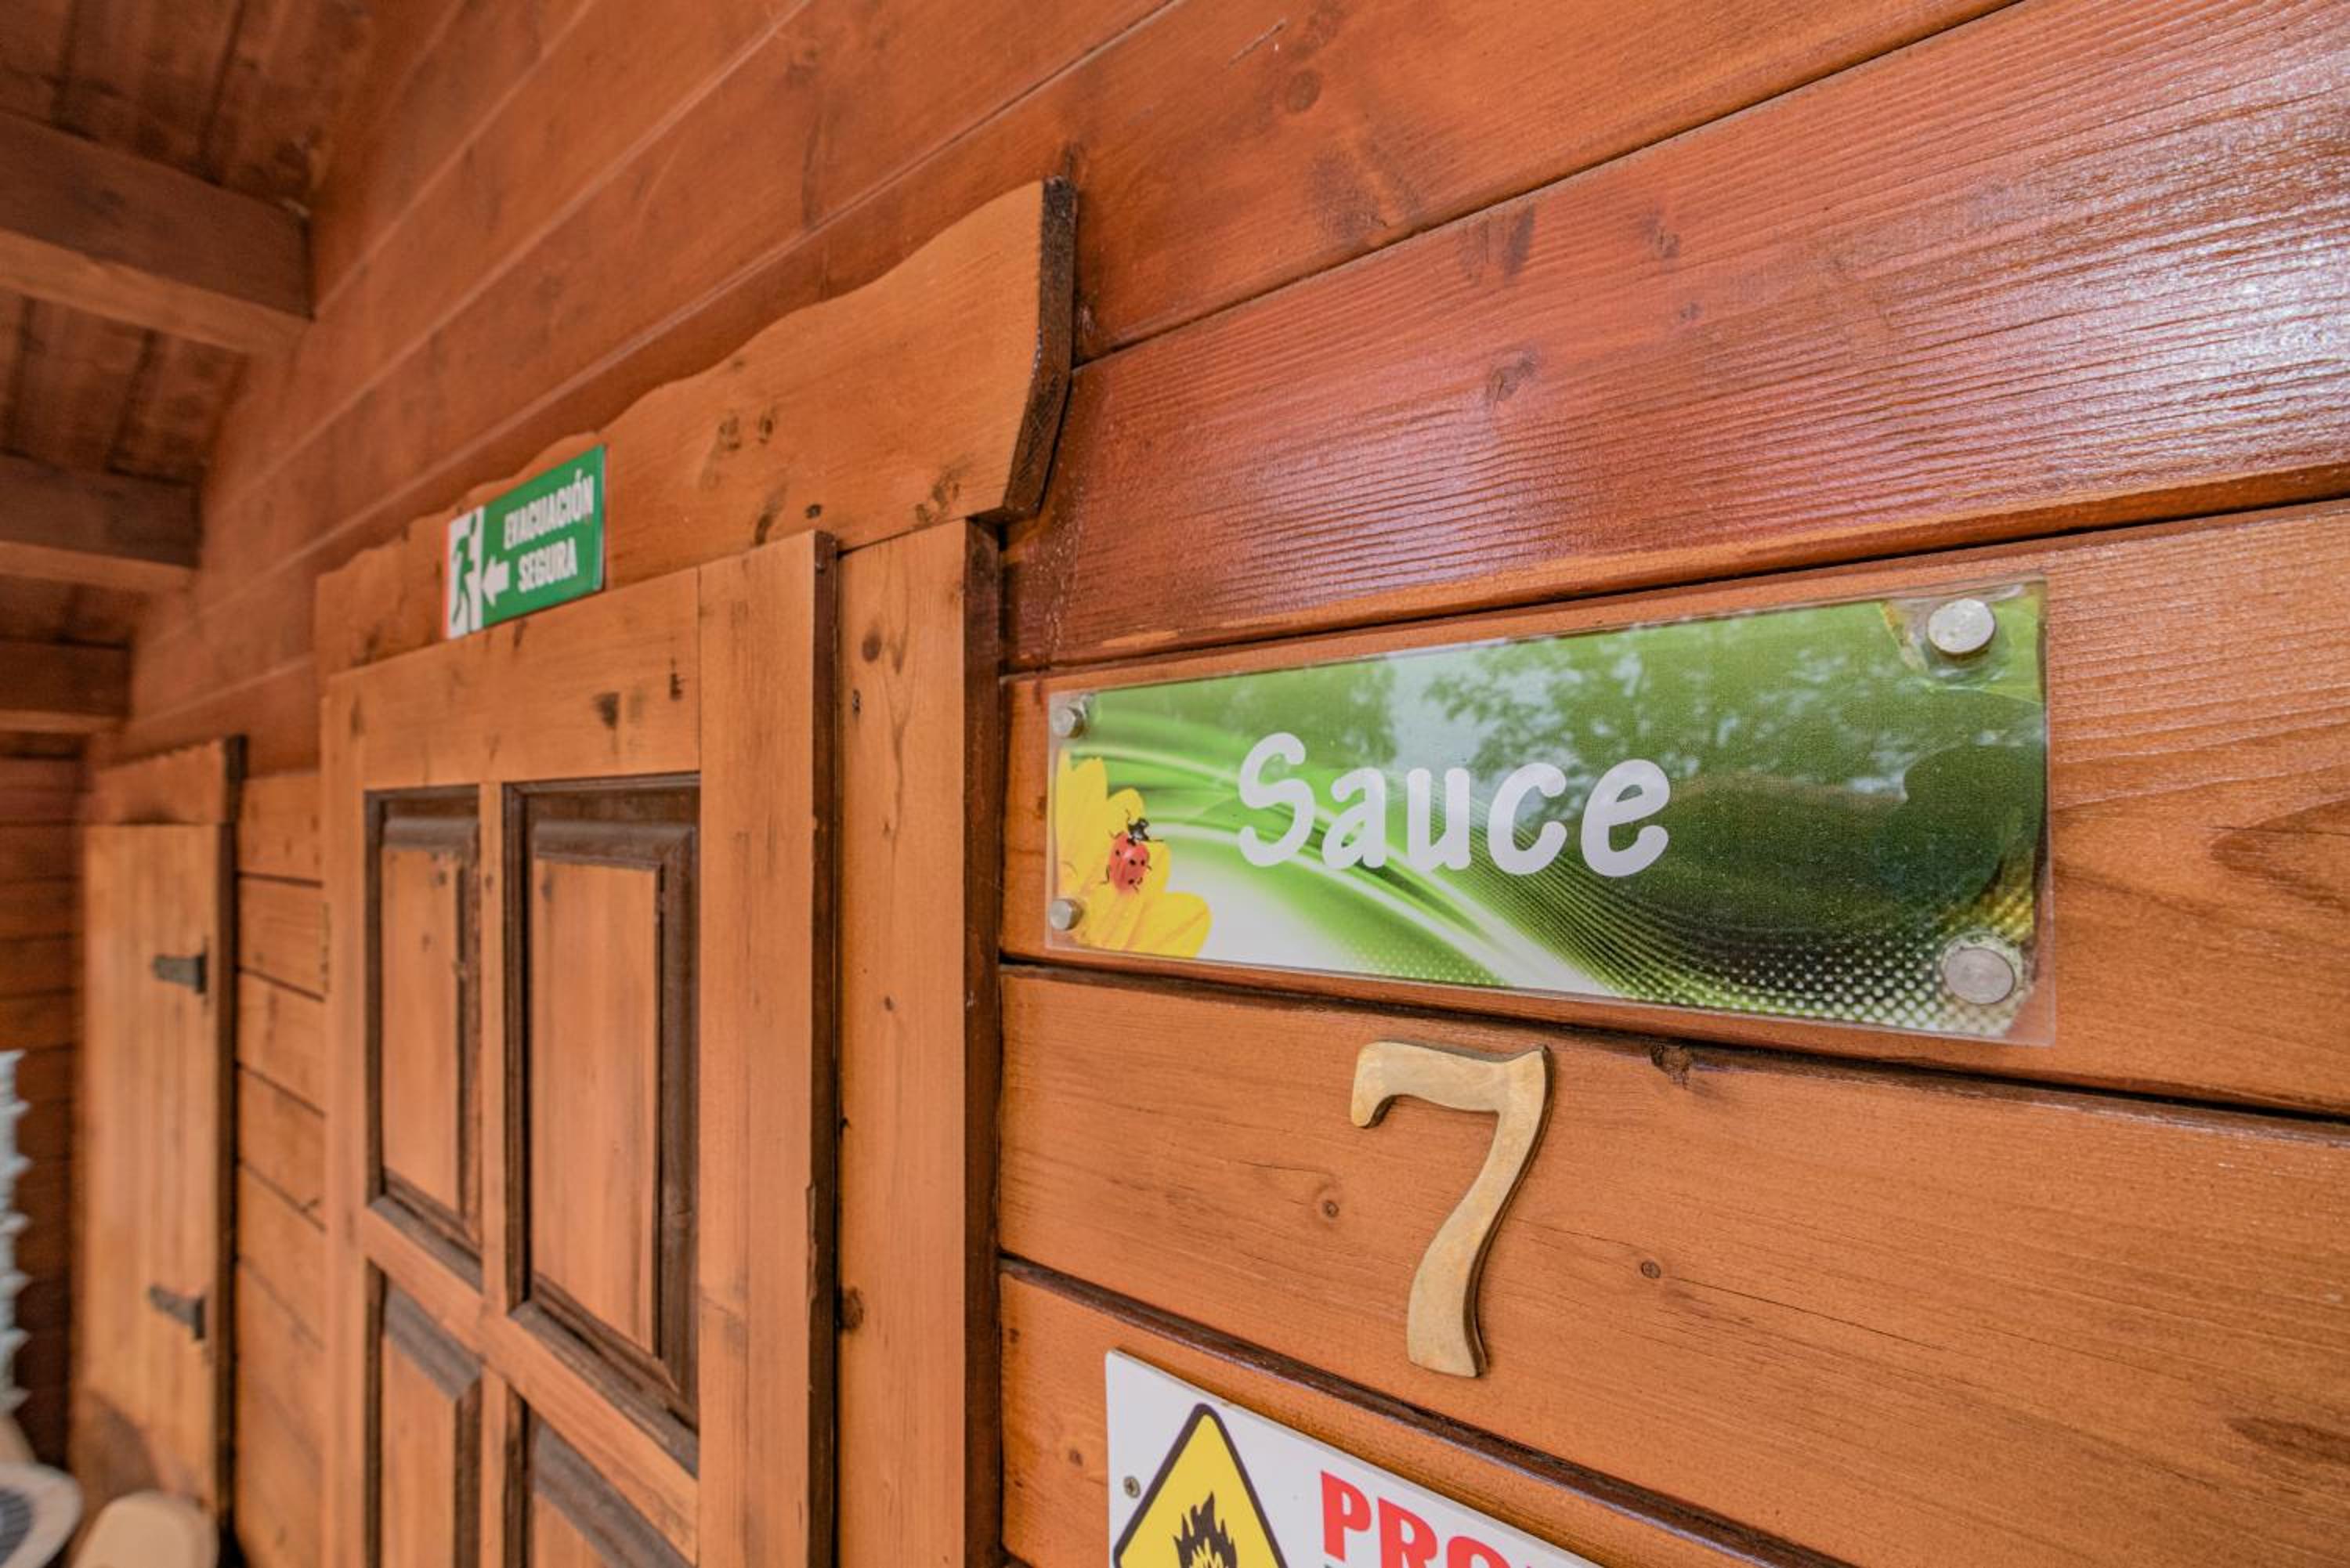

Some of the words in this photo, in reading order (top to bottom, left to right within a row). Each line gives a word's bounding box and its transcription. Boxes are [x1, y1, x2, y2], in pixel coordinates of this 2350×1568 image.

[504, 468, 594, 550] EVACUACIÓN
[518, 537, 577, 593] SEGURA
[1238, 732, 1671, 878] Sauce
[1350, 1040, 1553, 1378] 7
